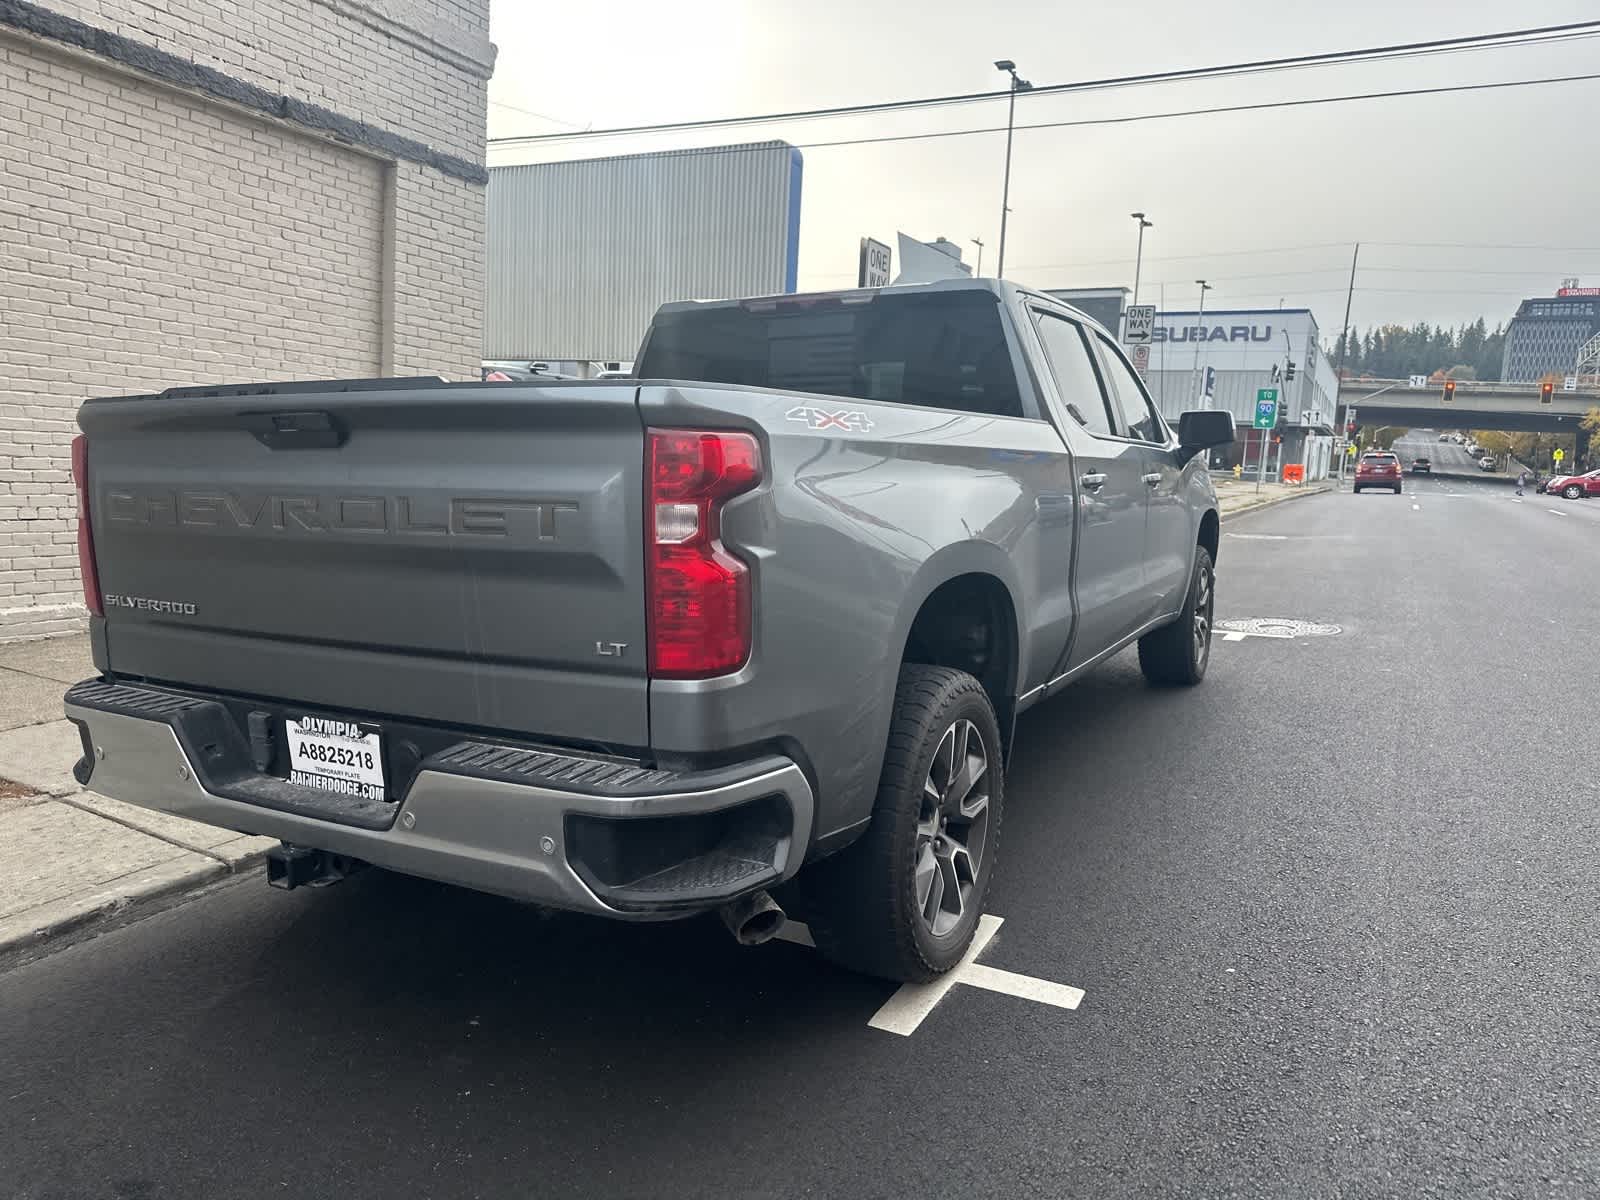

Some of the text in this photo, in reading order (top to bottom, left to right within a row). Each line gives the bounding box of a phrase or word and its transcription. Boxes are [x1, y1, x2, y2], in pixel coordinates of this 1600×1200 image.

[870, 248, 888, 272] ONE
[1128, 308, 1152, 319] ONE
[1128, 319, 1152, 329] WAY
[1151, 325, 1272, 343] SUBARU
[106, 490, 580, 540] CHEVROLET
[104, 594, 196, 615] SILVERADO
[595, 641, 628, 657] LT
[302, 715, 359, 739] OLYMPIA
[298, 741, 374, 770] A8825218
[315, 766, 361, 780] TEMPORARY PLATE
[290, 769, 385, 802] RAINIERDODGE.COM
